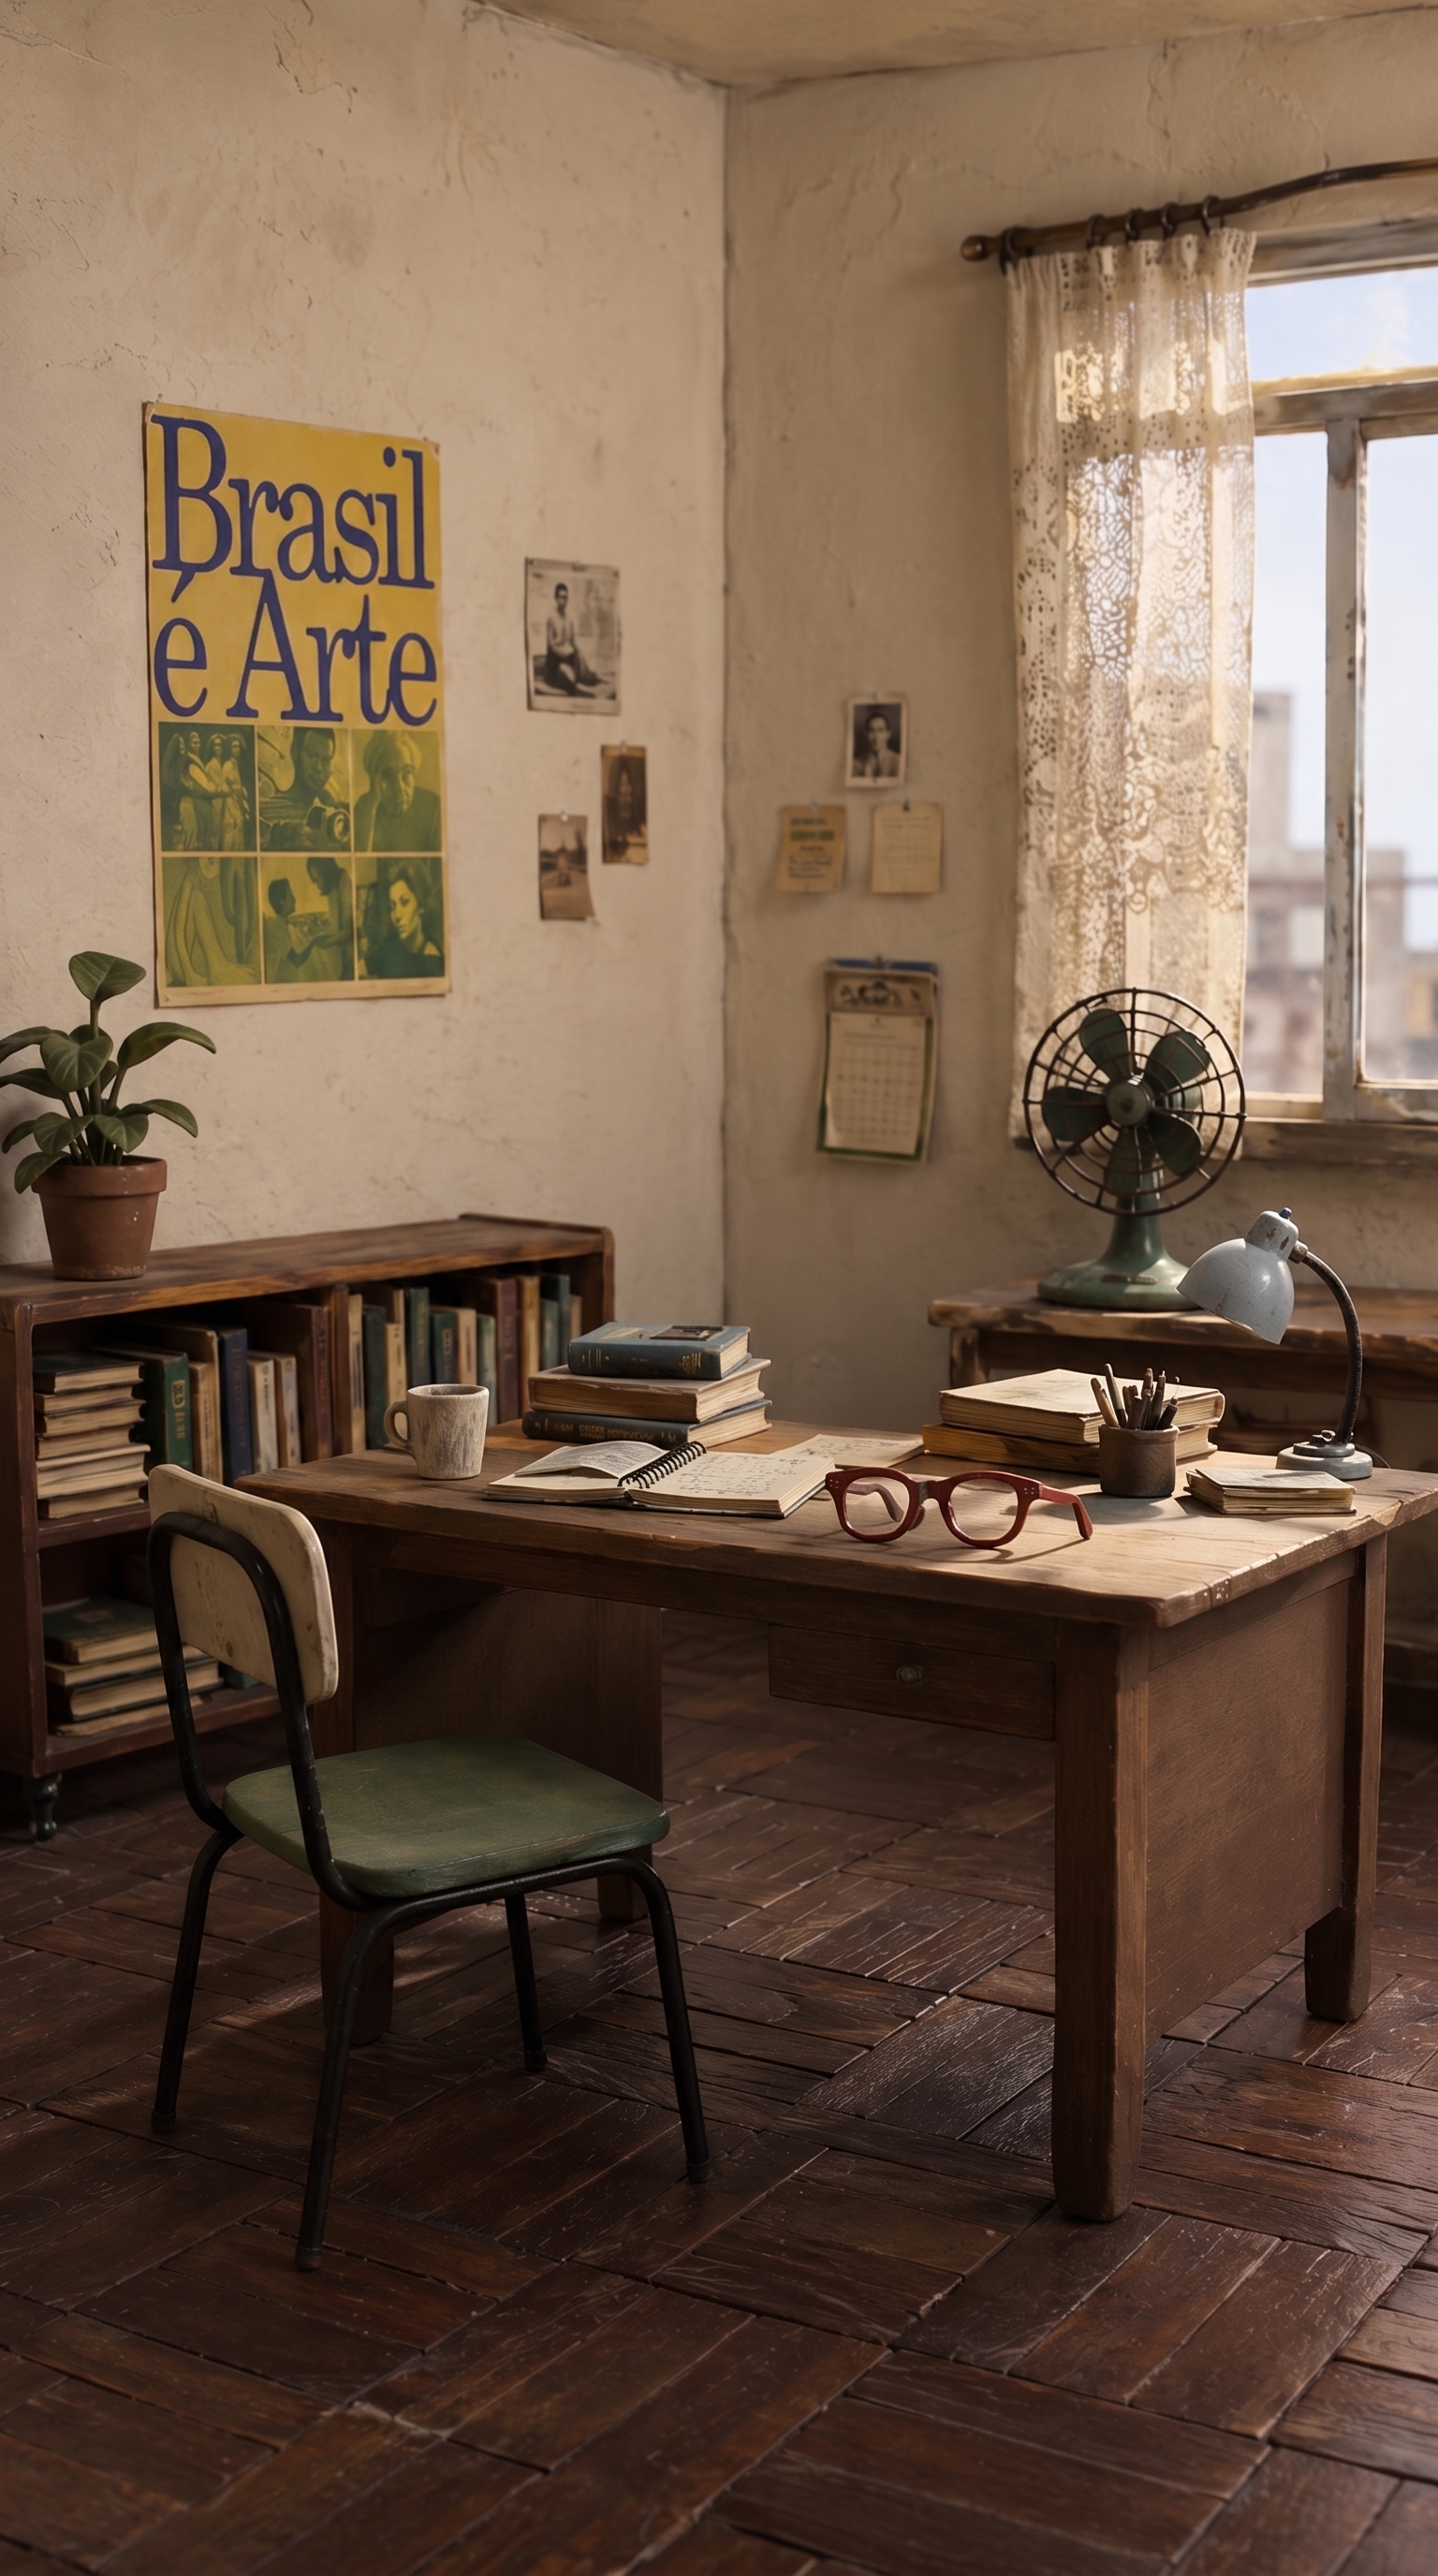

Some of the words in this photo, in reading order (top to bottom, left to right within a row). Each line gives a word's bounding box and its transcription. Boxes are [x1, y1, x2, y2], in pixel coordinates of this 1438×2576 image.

[151, 414, 435, 590] Brasil
[154, 570, 208, 718] é
[226, 569, 437, 726] Arte
